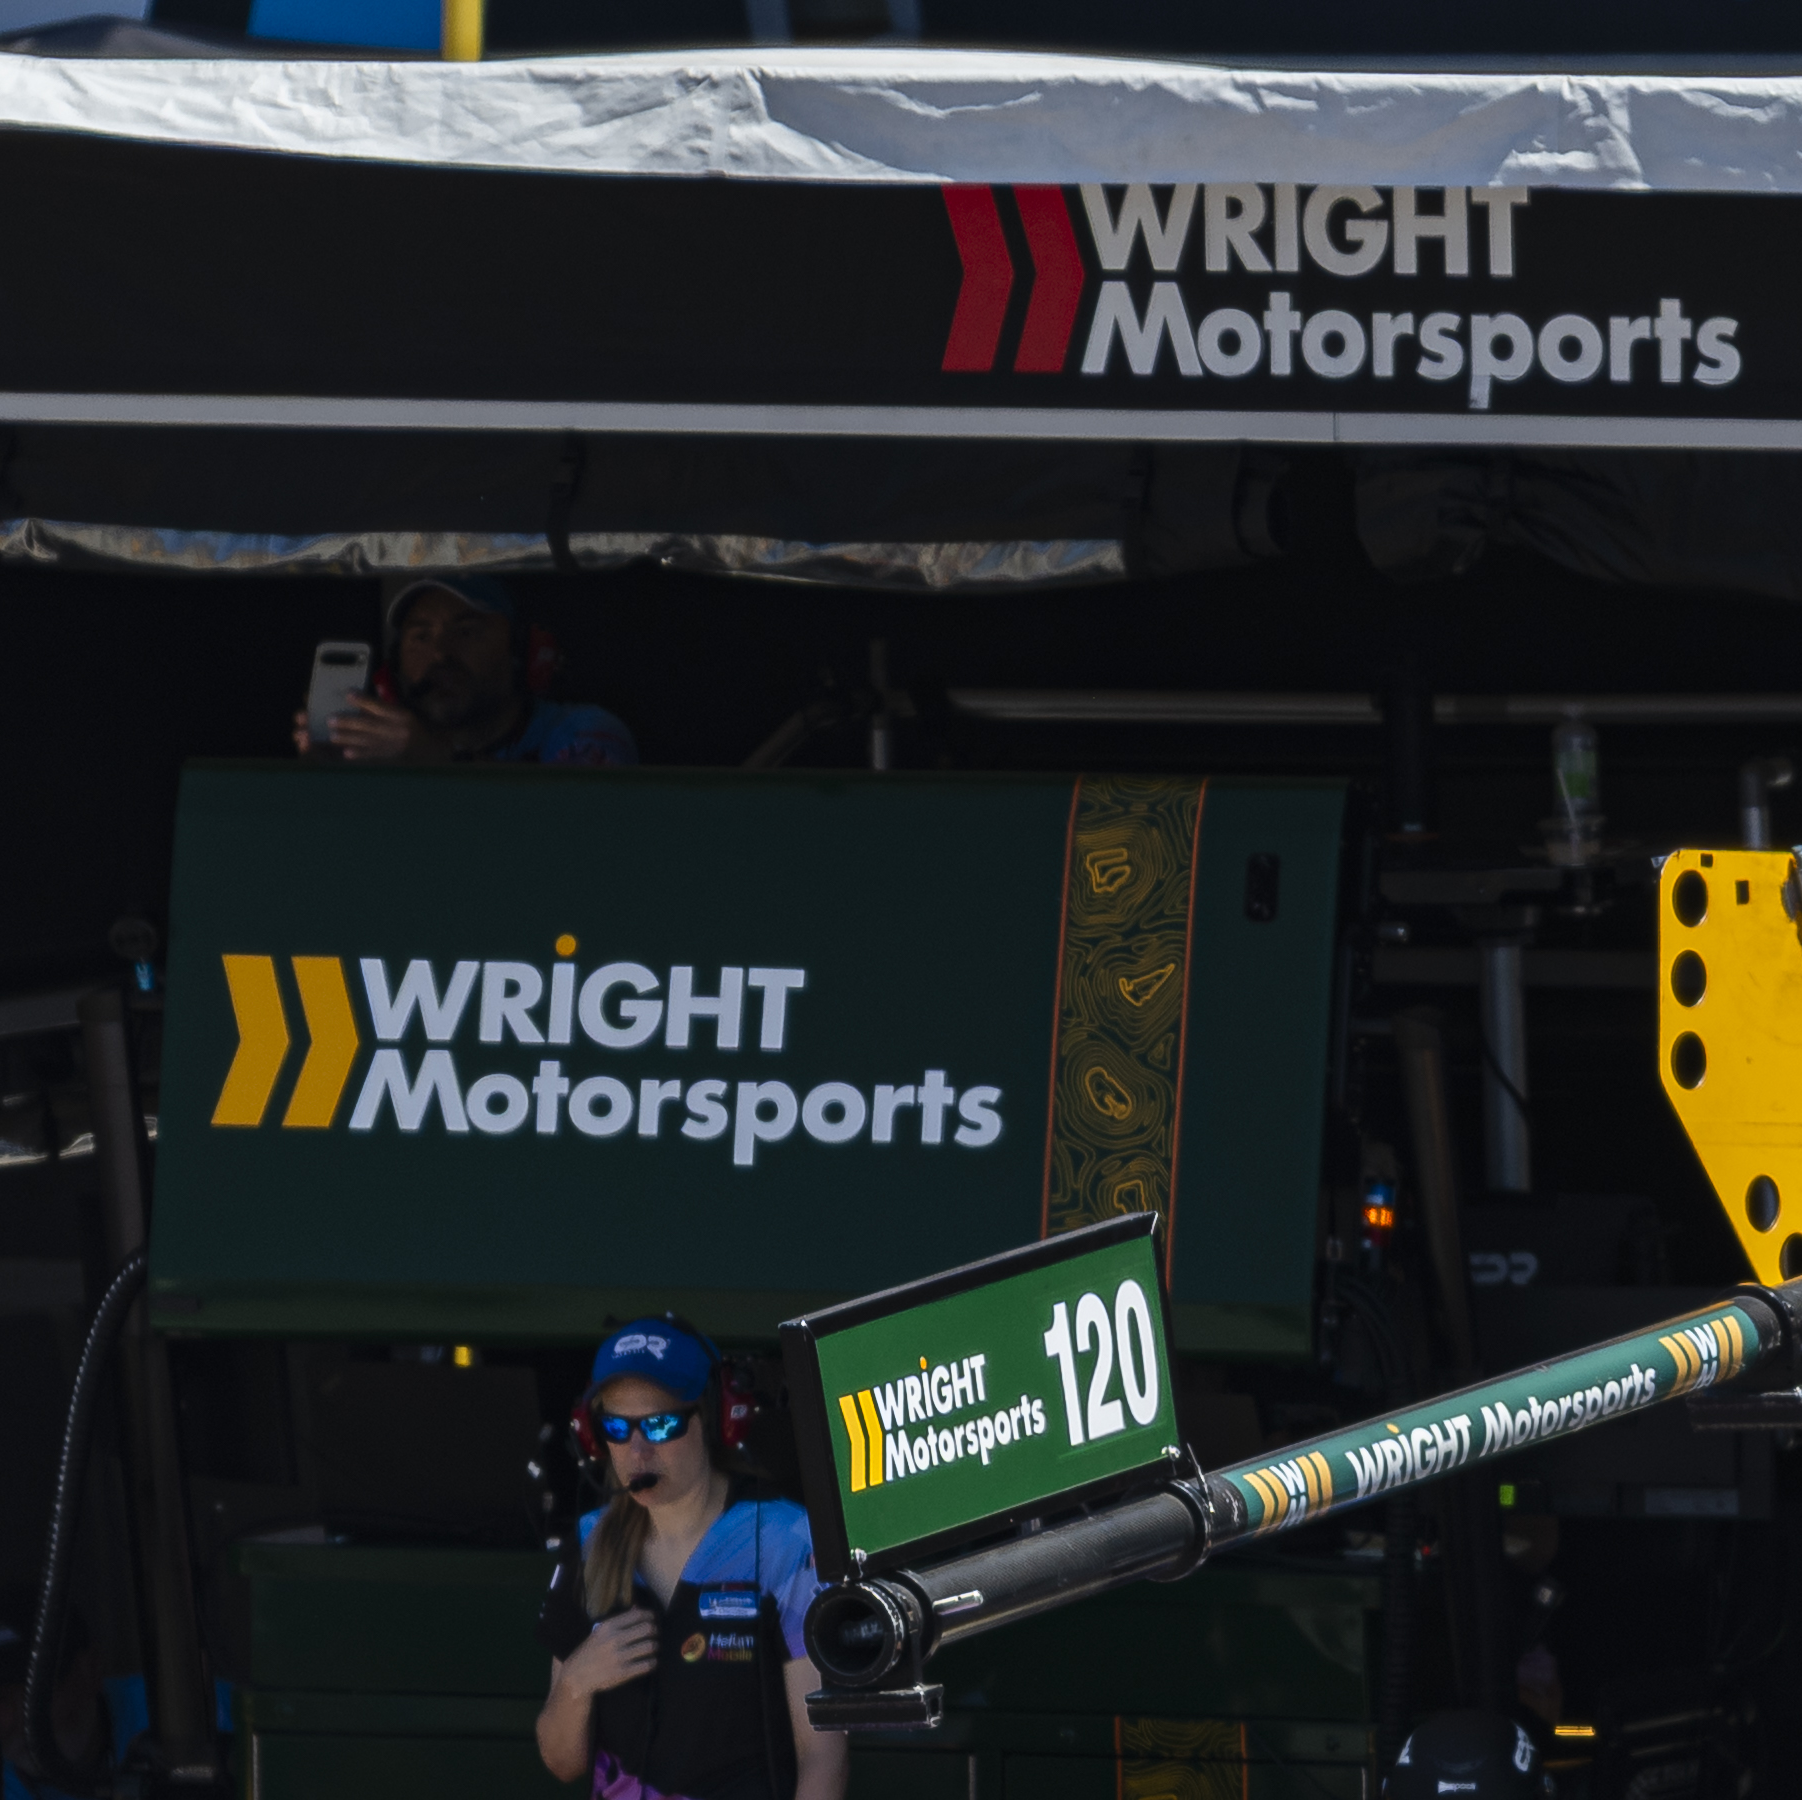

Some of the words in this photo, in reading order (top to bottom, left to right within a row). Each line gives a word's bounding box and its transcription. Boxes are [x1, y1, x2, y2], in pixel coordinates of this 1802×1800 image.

[1080, 182, 1531, 277] WRIGHT
[1080, 280, 1741, 409] Motorsports
[359, 934, 806, 1053] WRIGHT
[348, 1050, 1003, 1165] Motorsports
[873, 1353, 987, 1431] WRIGHT
[1042, 1278, 1160, 1447] 120
[885, 1394, 1047, 1483] Motorsports
[1344, 1423, 1473, 1499] WRIGHT
[1479, 1363, 1657, 1458] Motorsports
